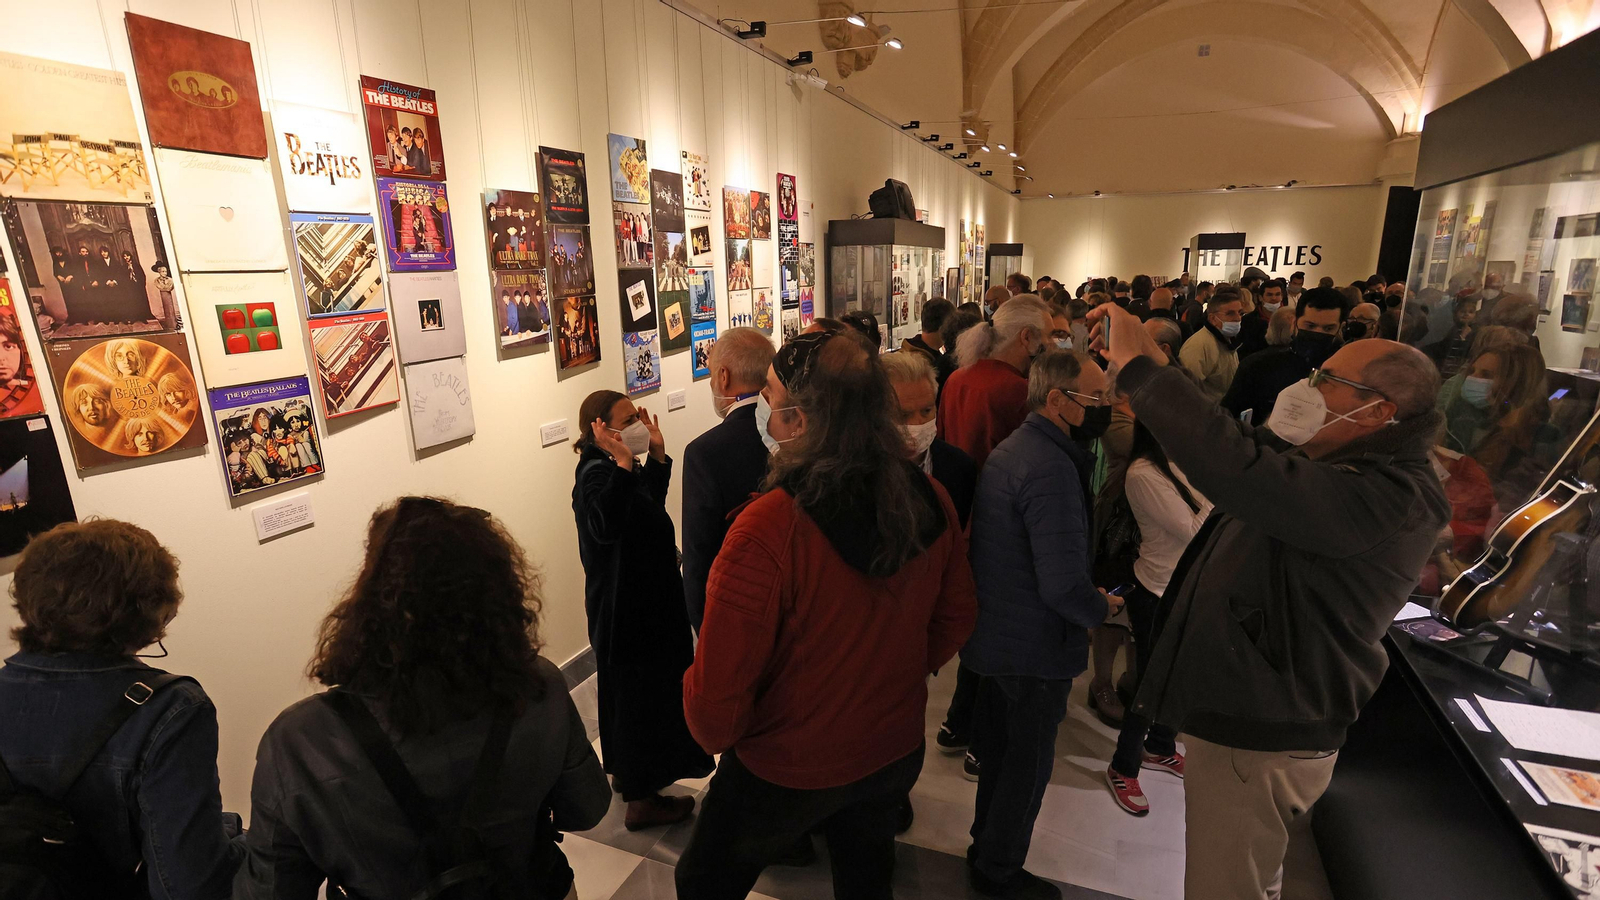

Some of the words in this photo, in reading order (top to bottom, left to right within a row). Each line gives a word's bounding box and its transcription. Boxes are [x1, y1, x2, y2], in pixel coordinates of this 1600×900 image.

[377, 80, 412, 102] History
[413, 88, 421, 103] of
[365, 90, 390, 106] THE
[390, 95, 434, 114] BEATLES
[22, 135, 42, 144] JOHN
[53, 133, 72, 142] PAUL
[315, 141, 331, 152] THE
[283, 132, 361, 186] BEATLES
[614, 181, 628, 190] THE
[1181, 247, 1220, 272] THE
[115, 383, 154, 399] BEATLES
[125, 378, 141, 388] THE
[224, 392, 240, 400] THE
[240, 387, 268, 398] BEATLES
[268, 383, 298, 394] BALLADS
[413, 390, 428, 416] THE
[432, 371, 470, 406] BEATLES
[129, 398, 148, 410] 20
